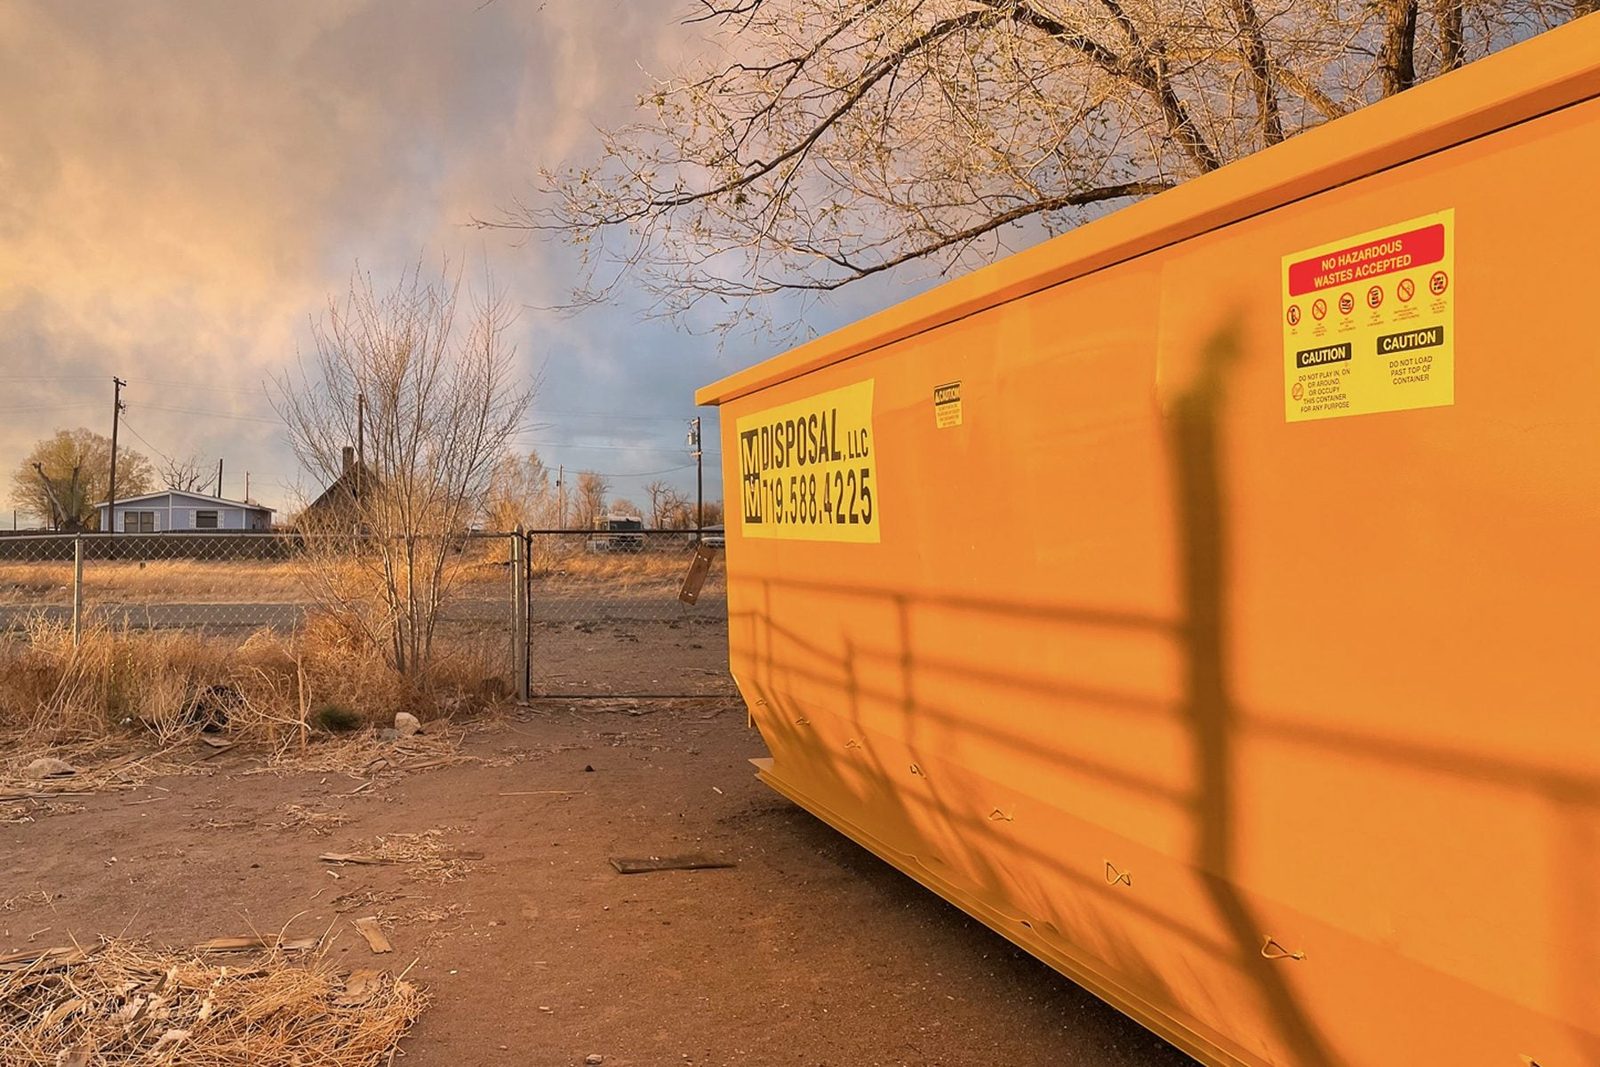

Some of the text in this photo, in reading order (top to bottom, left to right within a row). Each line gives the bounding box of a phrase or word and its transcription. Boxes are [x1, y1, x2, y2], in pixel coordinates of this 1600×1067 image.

[1321, 239, 1403, 271] NO HAZARDOUS
[1313, 254, 1412, 288] WASTES ACCEPTED
[1382, 330, 1436, 351] CAUTION
[1301, 346, 1346, 365] CAUTION
[1389, 356, 1433, 368] DO NOT LOAD
[1391, 364, 1431, 376] PAST TOP OF
[1298, 374, 1306, 382] DO
[1319, 371, 1333, 379] PLAY
[1392, 373, 1430, 385] CONTAINER
[1317, 386, 1340, 395] OCCUPY
[1316, 393, 1346, 403] CONTAINER
[1301, 405, 1311, 413] FOR
[1324, 401, 1350, 409] PURPOSE
[848, 428, 869, 459] LLC
[763, 468, 872, 524] 719.588.4225
